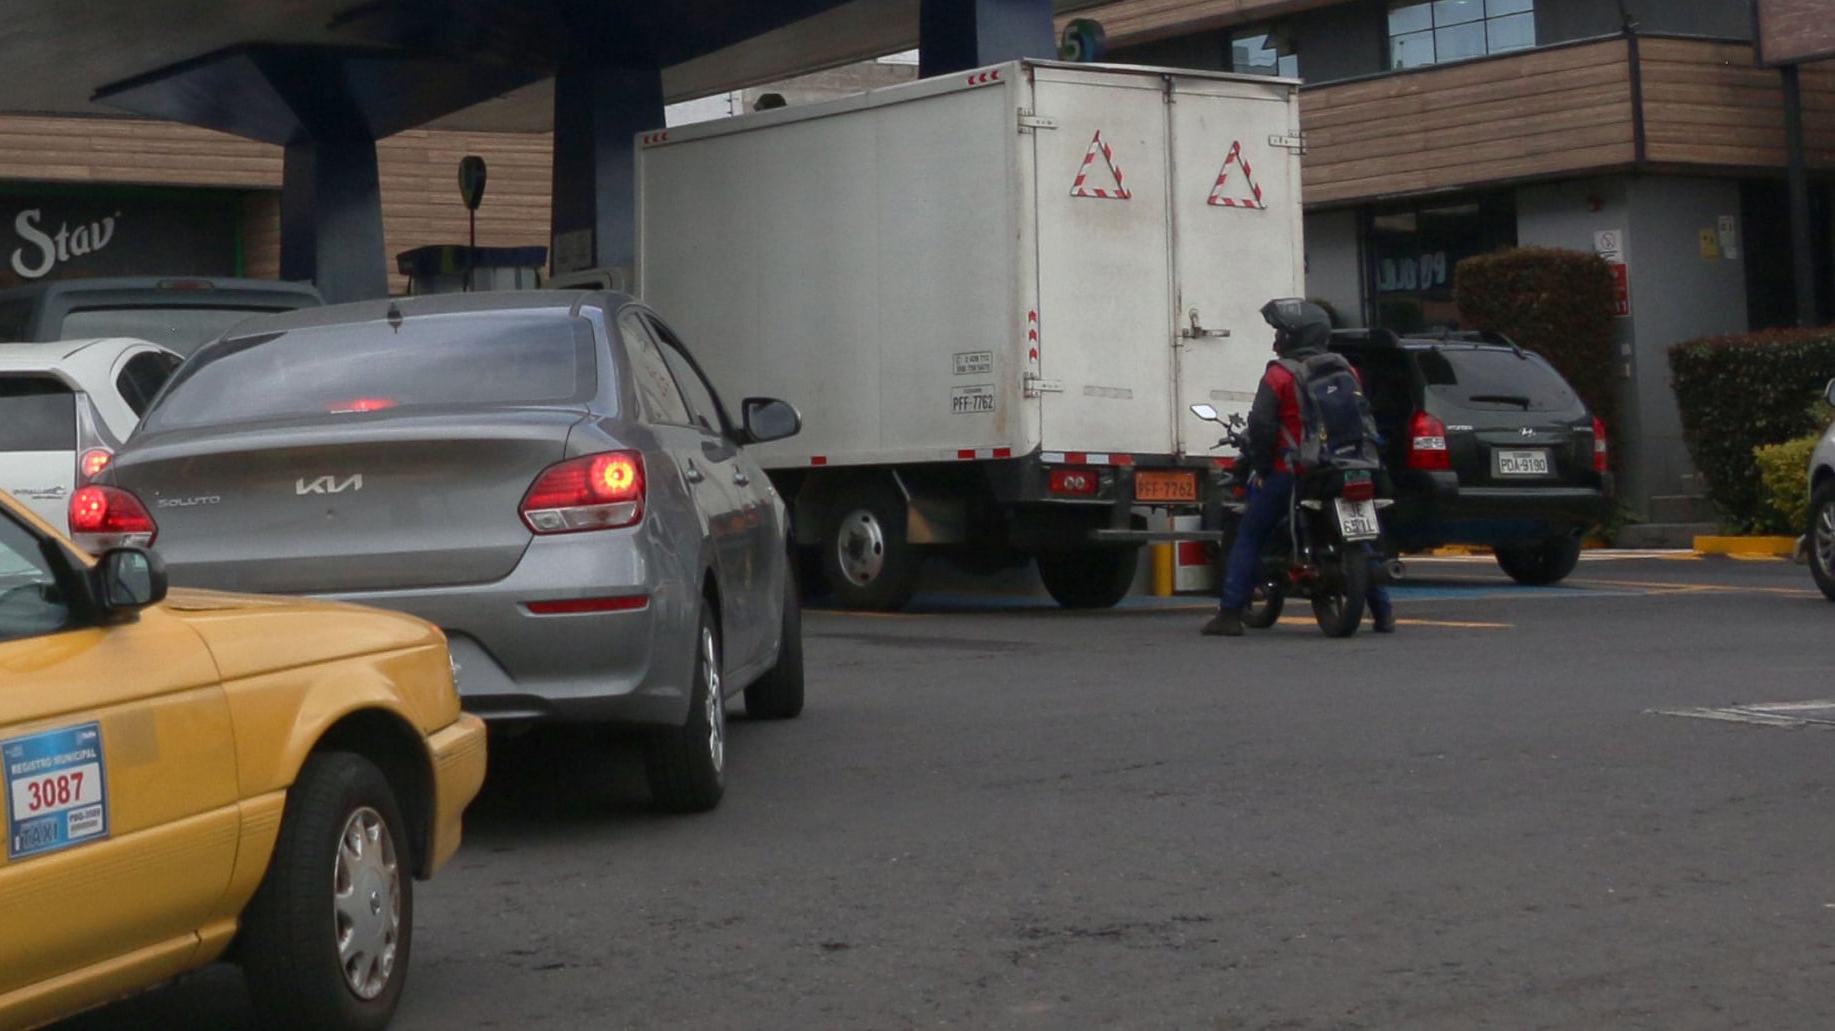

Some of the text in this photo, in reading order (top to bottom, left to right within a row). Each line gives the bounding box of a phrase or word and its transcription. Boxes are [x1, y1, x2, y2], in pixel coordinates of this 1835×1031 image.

[1062, 26, 1081, 60] 5
[12, 209, 115, 278] Stav
[953, 394, 993, 411] PFF-7762
[1501, 458, 1546, 472] PDA-9190
[158, 495, 220, 508] SOLUTO
[1138, 481, 1193, 498] PFF-7762
[12, 748, 97, 775] REGISTRO MUNICIPAL
[28, 771, 83, 811] 3087
[21, 822, 58, 847] TAXI
